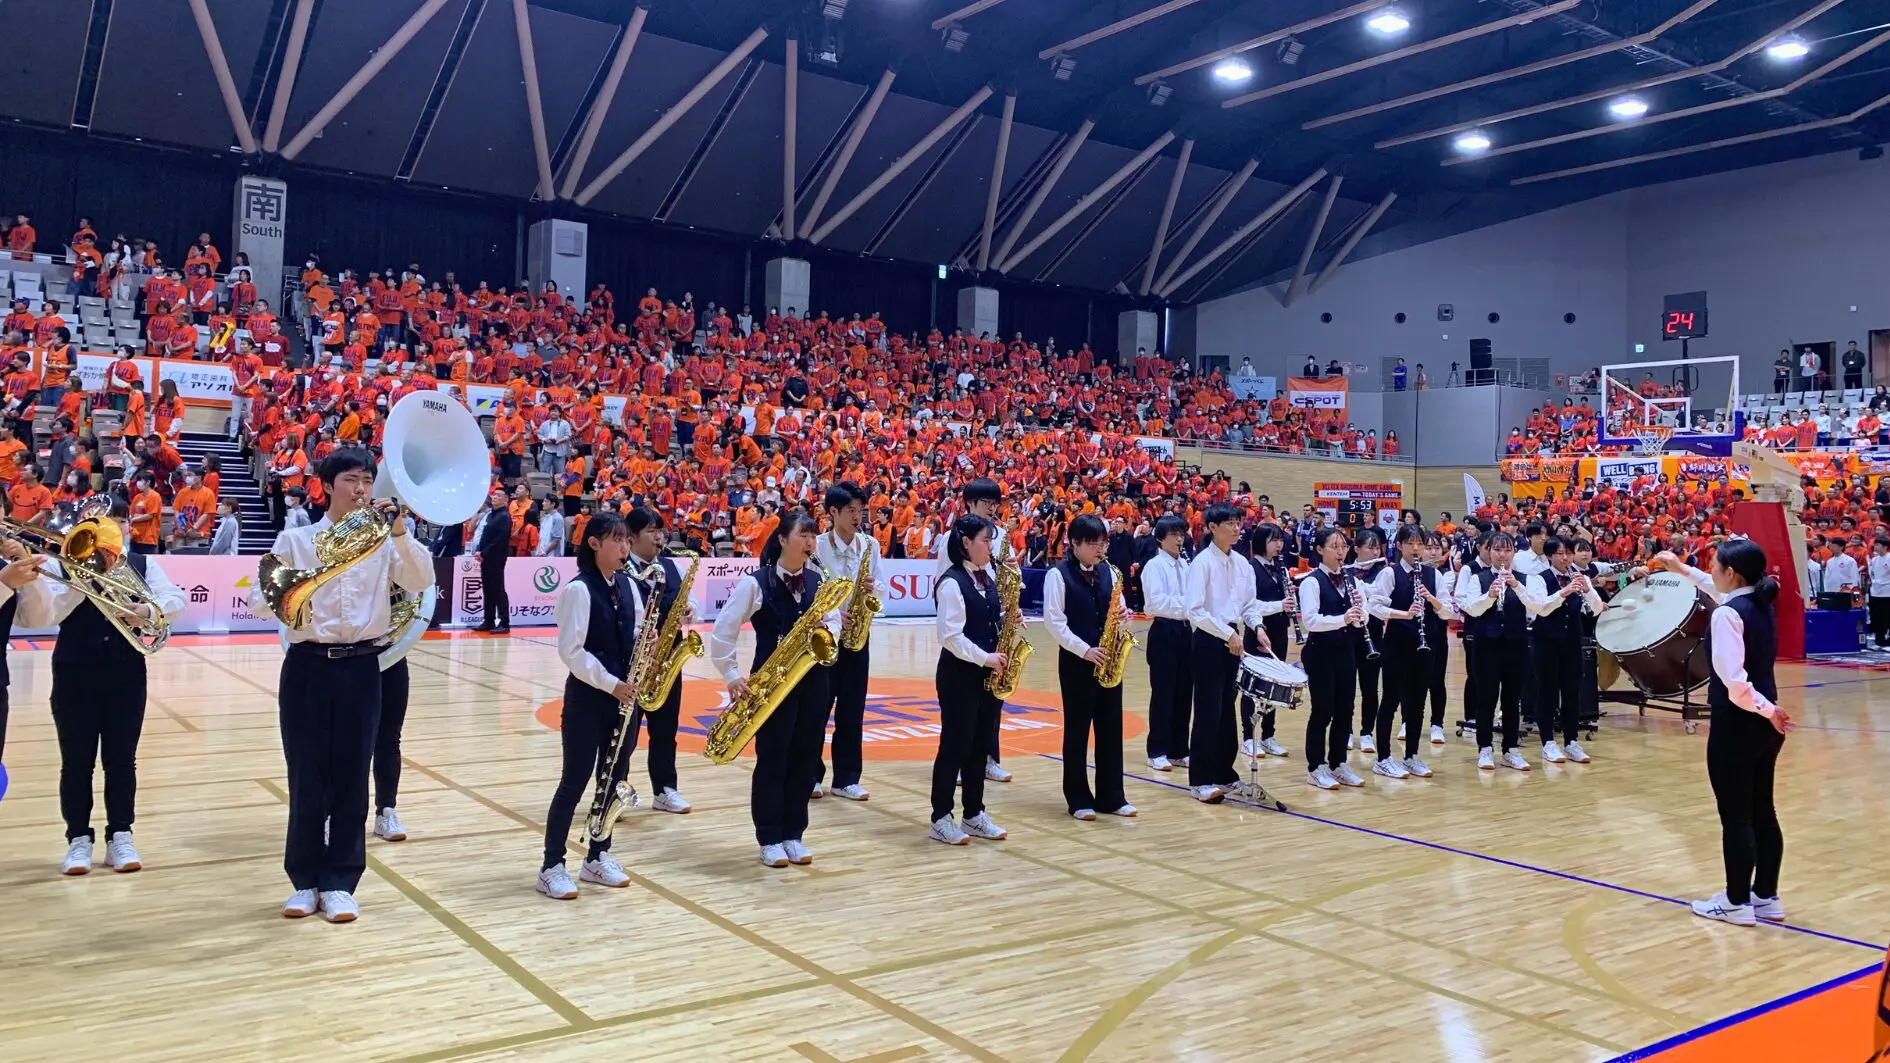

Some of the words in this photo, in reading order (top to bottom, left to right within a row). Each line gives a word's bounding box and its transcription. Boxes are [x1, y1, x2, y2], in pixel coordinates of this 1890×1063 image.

[245, 183, 283, 222] 南
[242, 223, 283, 238] South
[1667, 312, 1693, 333] 24
[423, 400, 447, 413] YAMAHA
[1603, 464, 1627, 476] WELL
[1350, 500, 1372, 510] 5:53
[888, 573, 937, 601] SU
[1654, 580, 1681, 588] YAMAHA
